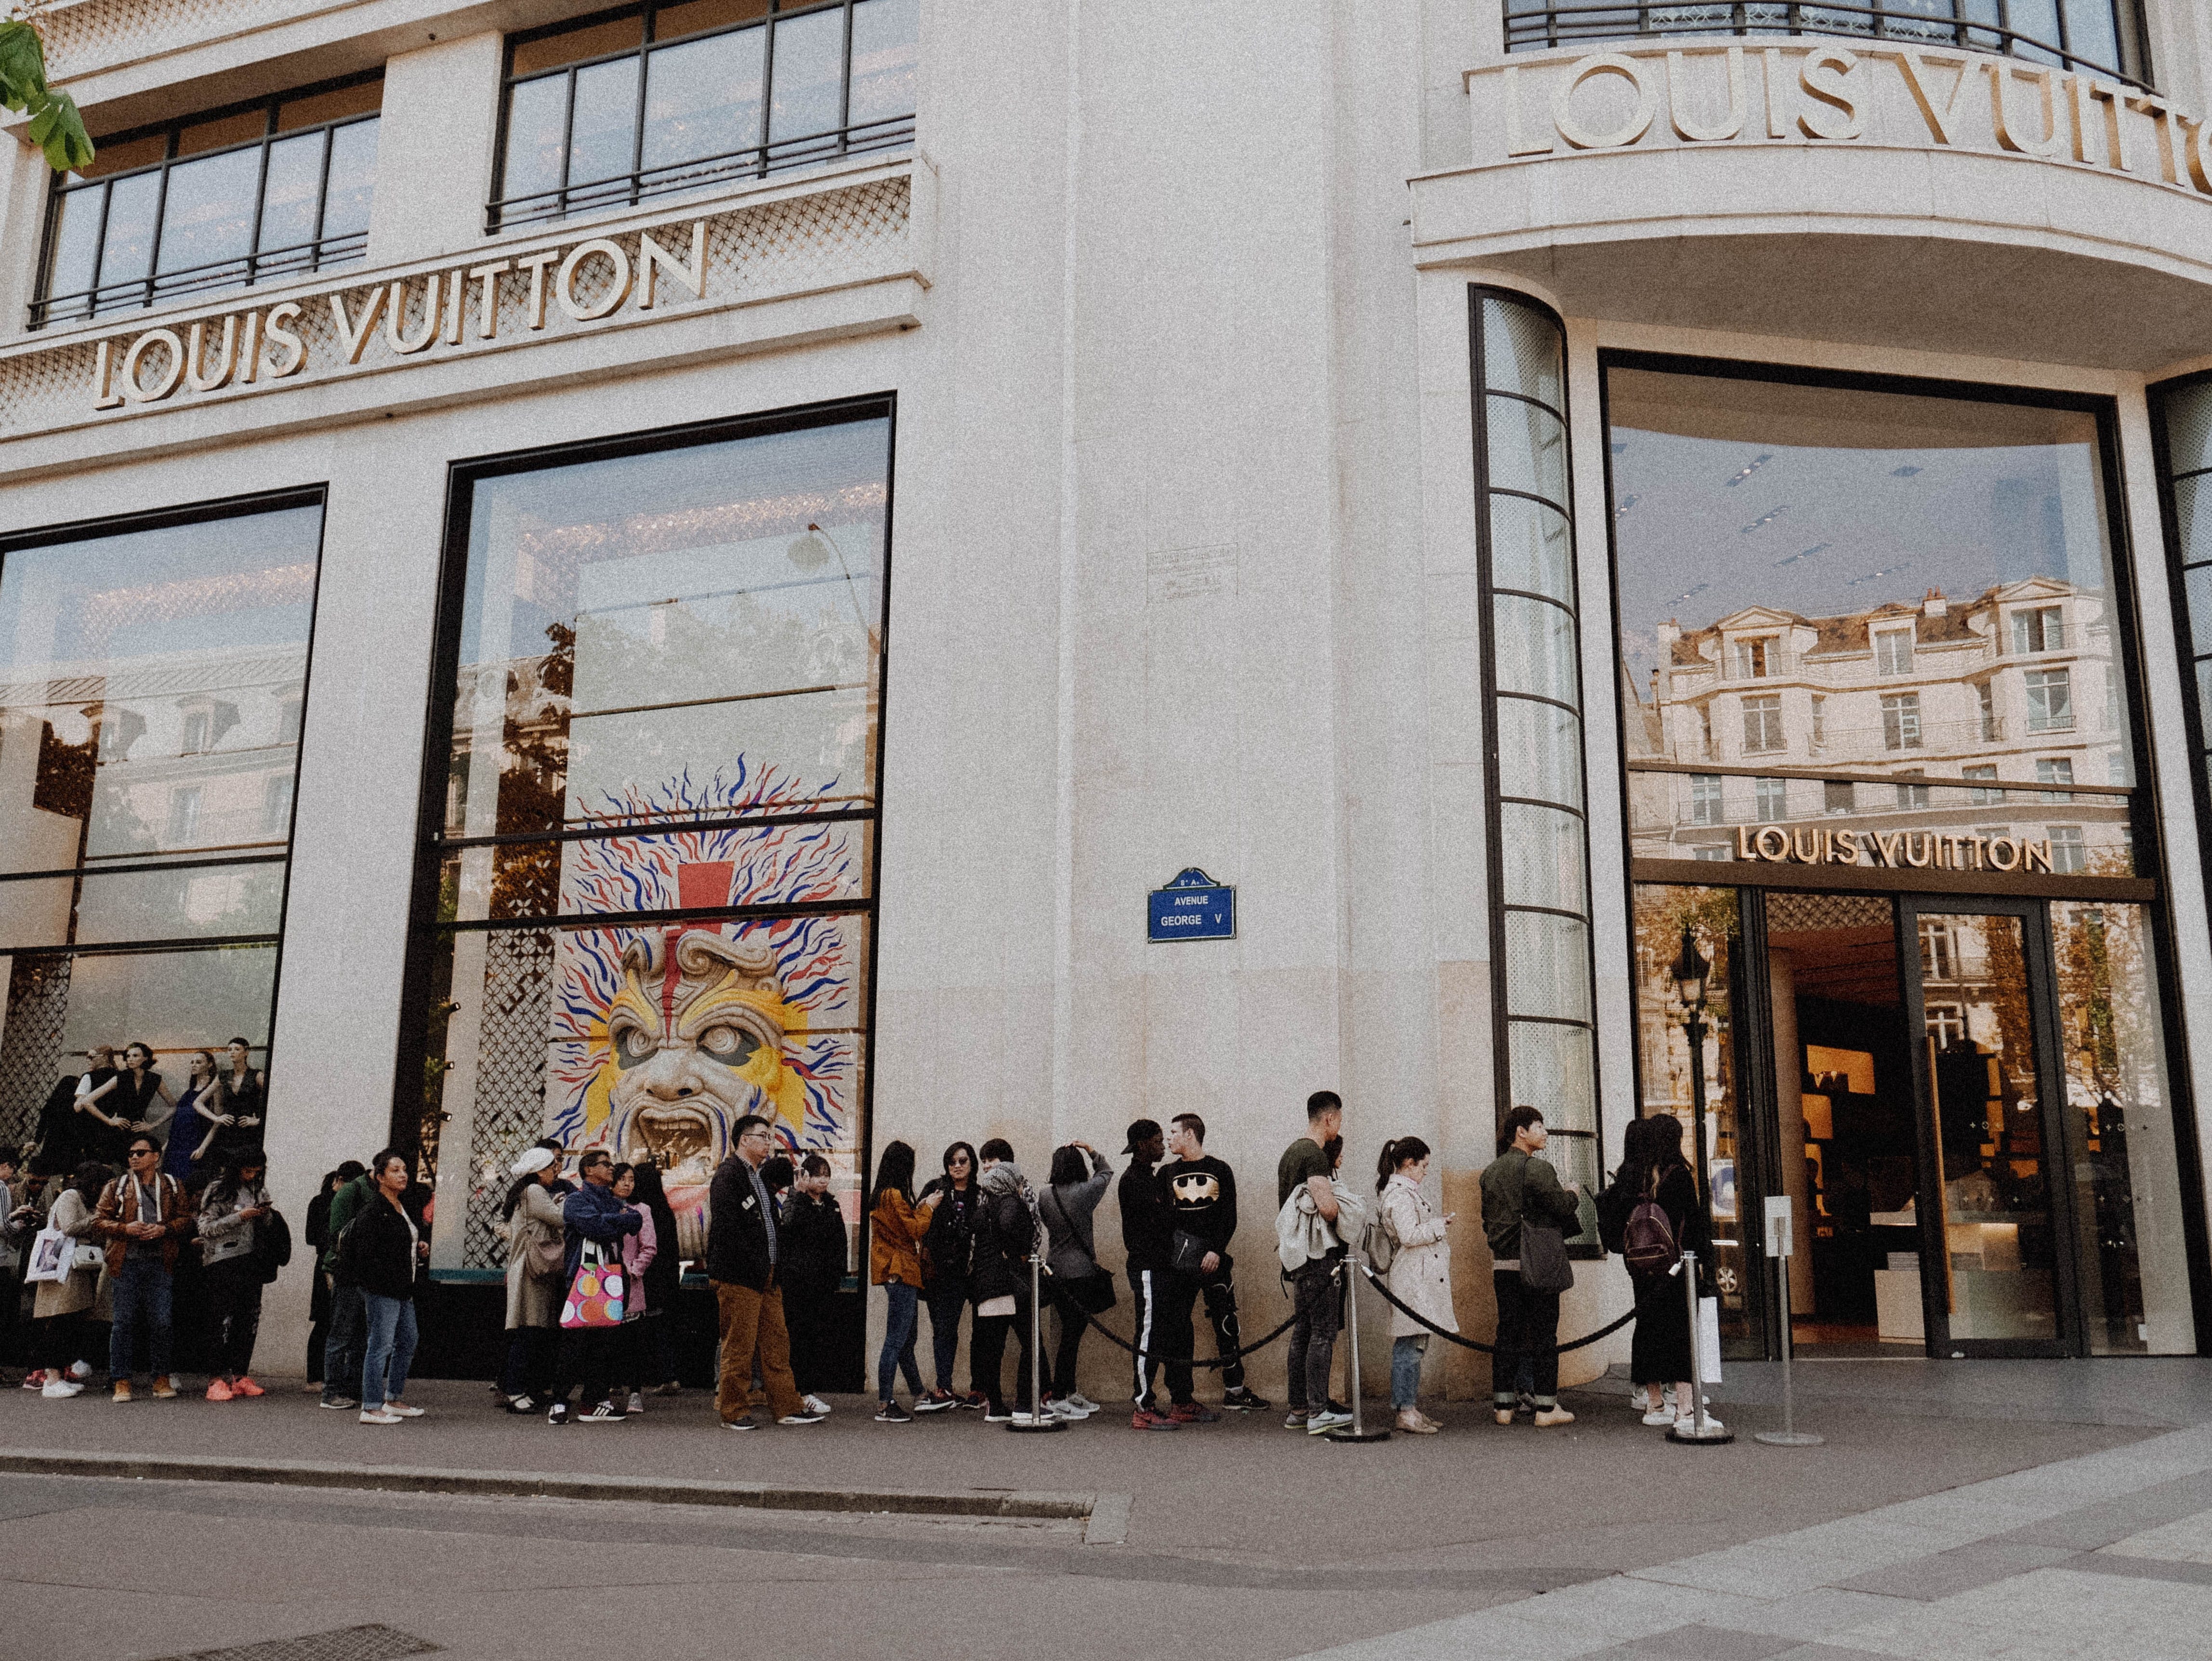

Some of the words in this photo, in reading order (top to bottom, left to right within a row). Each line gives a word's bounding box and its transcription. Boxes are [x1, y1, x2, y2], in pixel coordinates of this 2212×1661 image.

[1503, 46, 1863, 158] LOUIS
[93, 302, 307, 410] LOUIS
[329, 221, 708, 364] VUITTON
[1737, 825, 1859, 864] LOUIS
[1870, 830, 2054, 873] VUITTON
[1161, 914, 1202, 926] GEORGE
[1214, 913, 1222, 923] V
[1174, 895, 1208, 906] AVENUE
